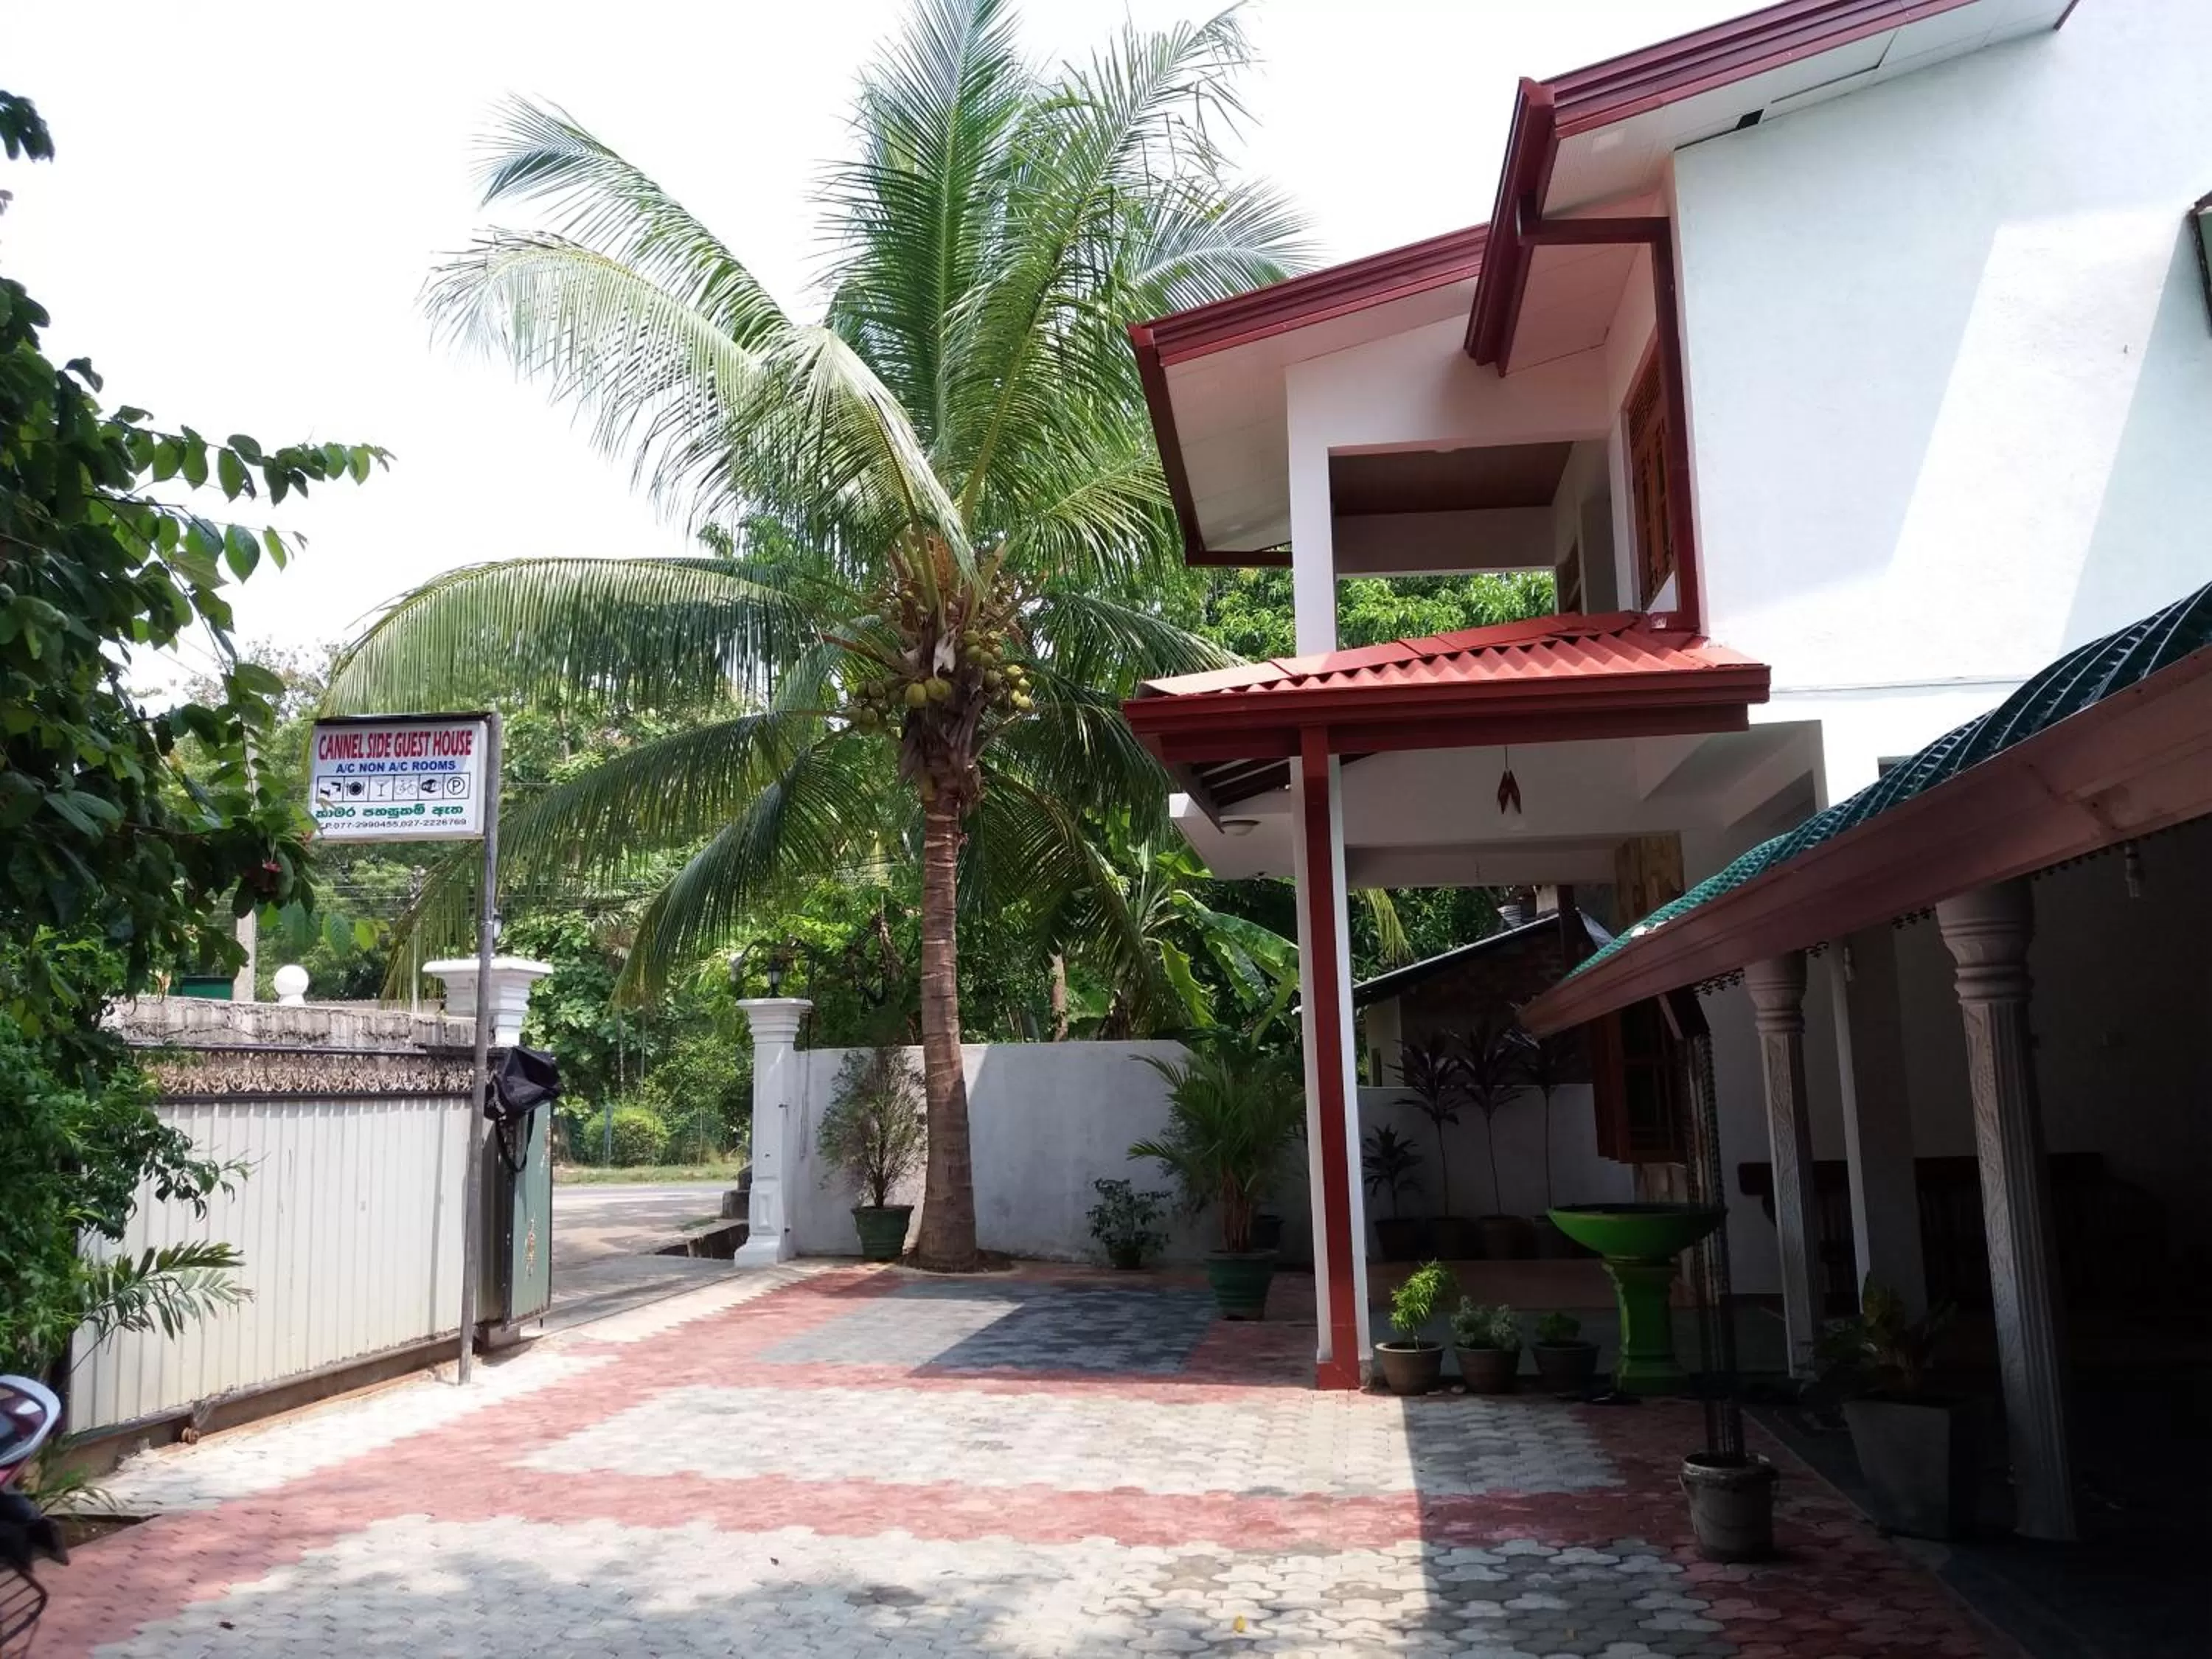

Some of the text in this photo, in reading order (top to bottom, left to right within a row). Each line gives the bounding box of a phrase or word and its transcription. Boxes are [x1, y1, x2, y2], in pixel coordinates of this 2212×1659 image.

[319, 730, 473, 760] CANNEL SIDE GUEST HOUSE
[336, 760, 456, 773] A/C NON A/C ROOMS
